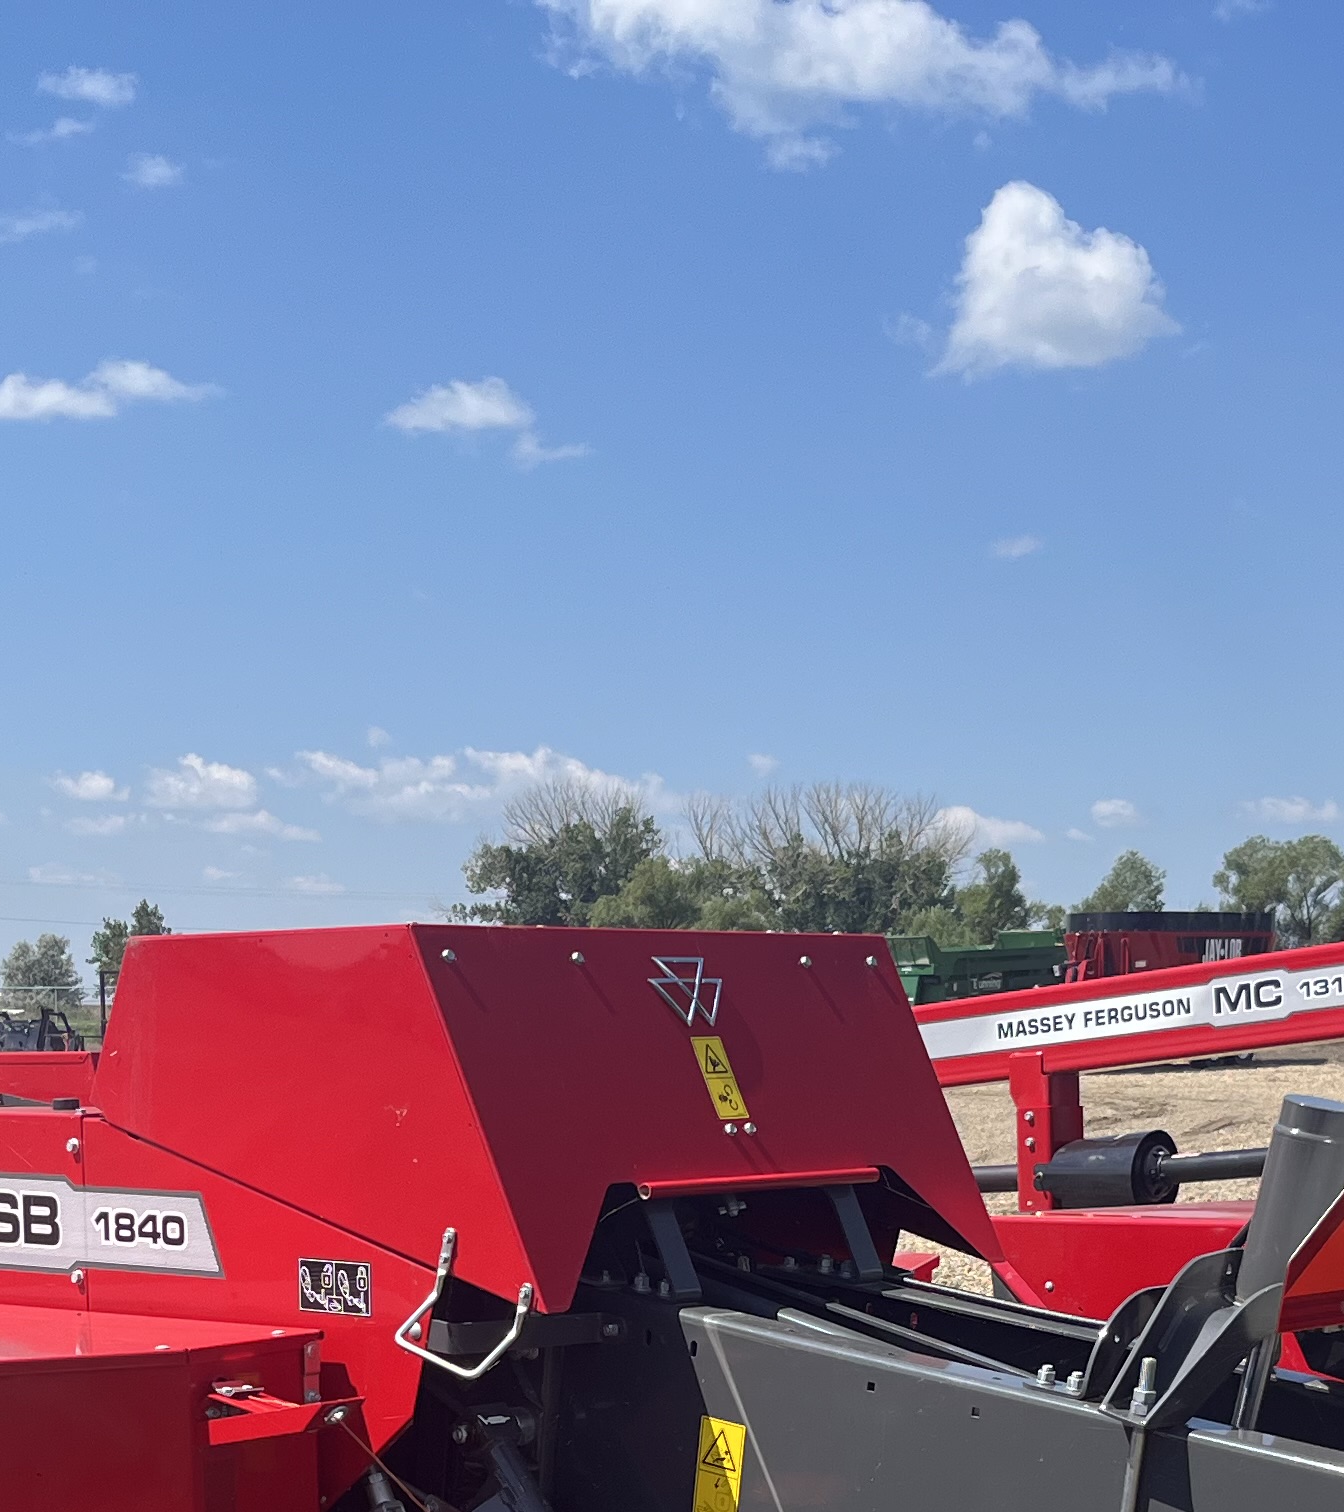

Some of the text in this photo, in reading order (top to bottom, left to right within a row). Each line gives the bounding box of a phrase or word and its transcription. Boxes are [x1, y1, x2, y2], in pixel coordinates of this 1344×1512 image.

[996, 1012, 1076, 1040] MASSEY
[1083, 997, 1192, 1029] FERGUSON
[1213, 978, 1283, 1015] MC
[93, 1211, 186, 1247] 1840
